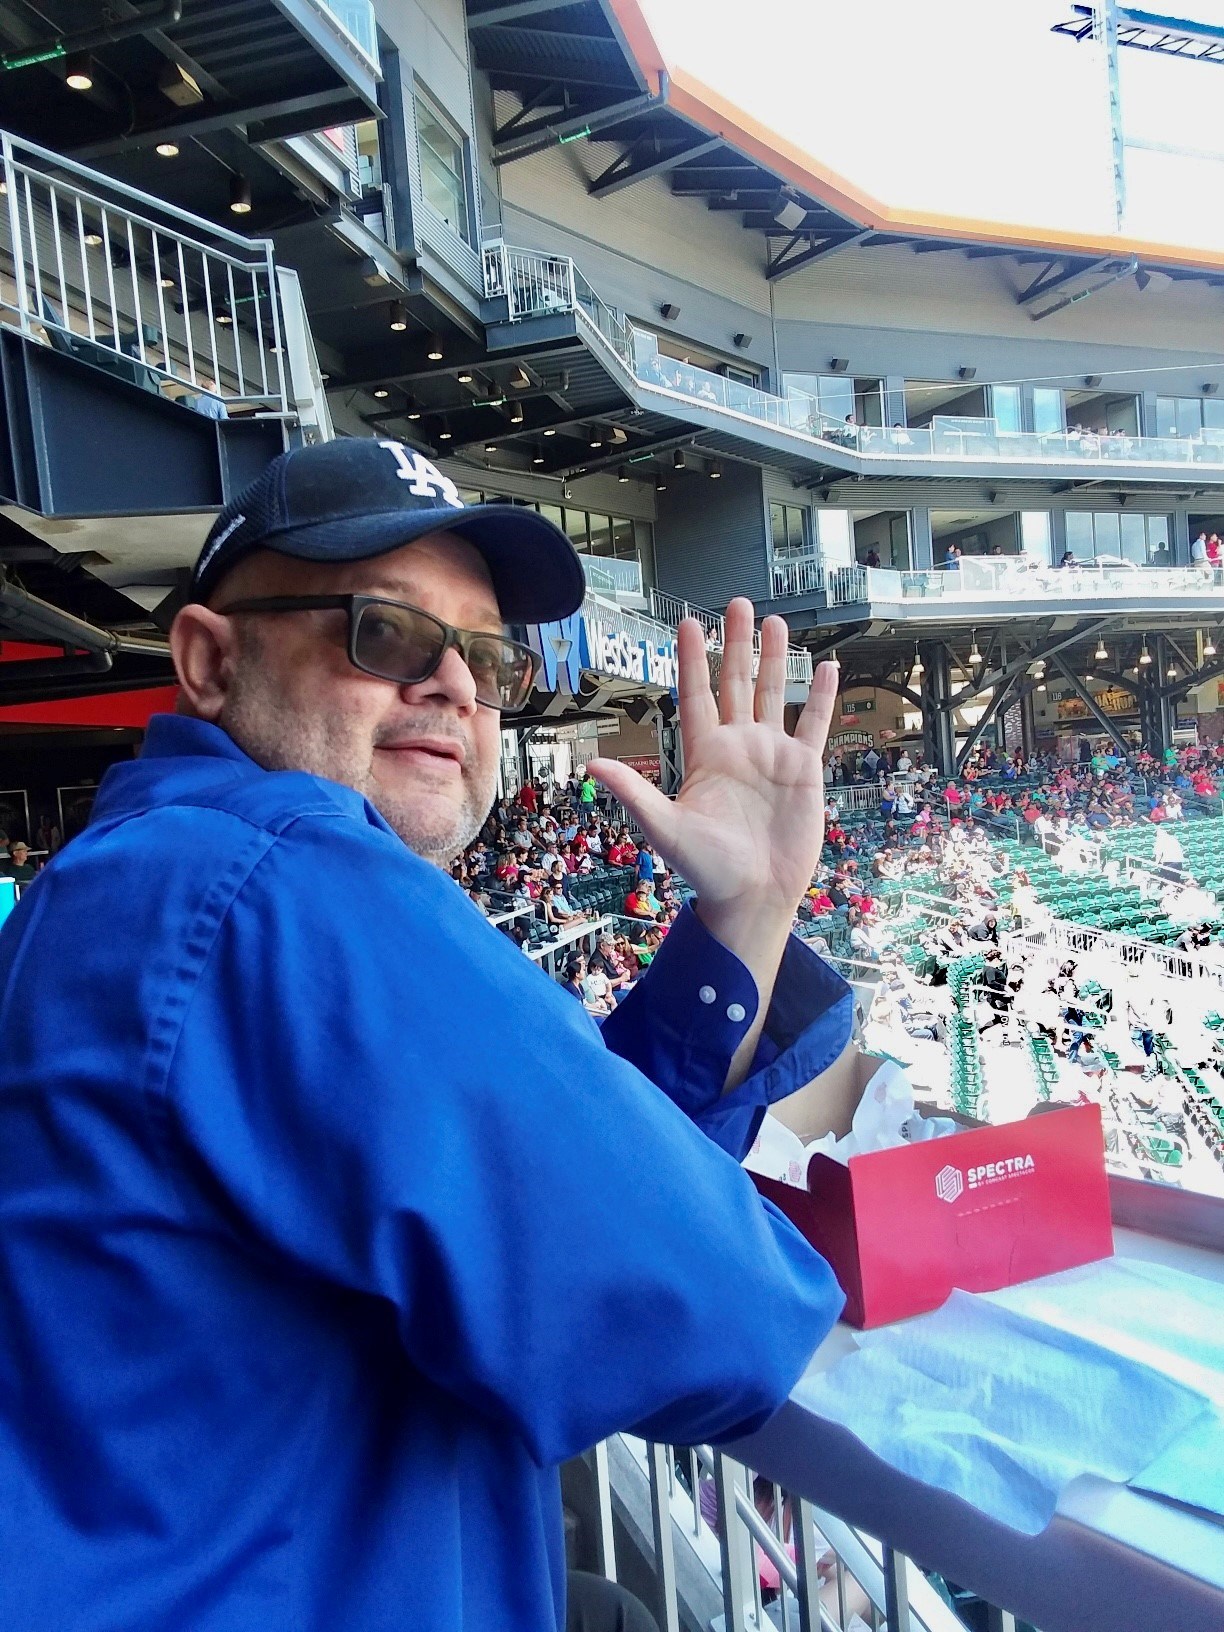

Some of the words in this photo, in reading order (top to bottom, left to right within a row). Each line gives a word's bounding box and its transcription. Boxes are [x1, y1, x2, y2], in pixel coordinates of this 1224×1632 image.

[379, 440, 465, 509] LA
[584, 616, 645, 682] WestStar
[828, 733, 874, 751] CHAMPIONS
[967, 1153, 1035, 1182] SPECTRA
